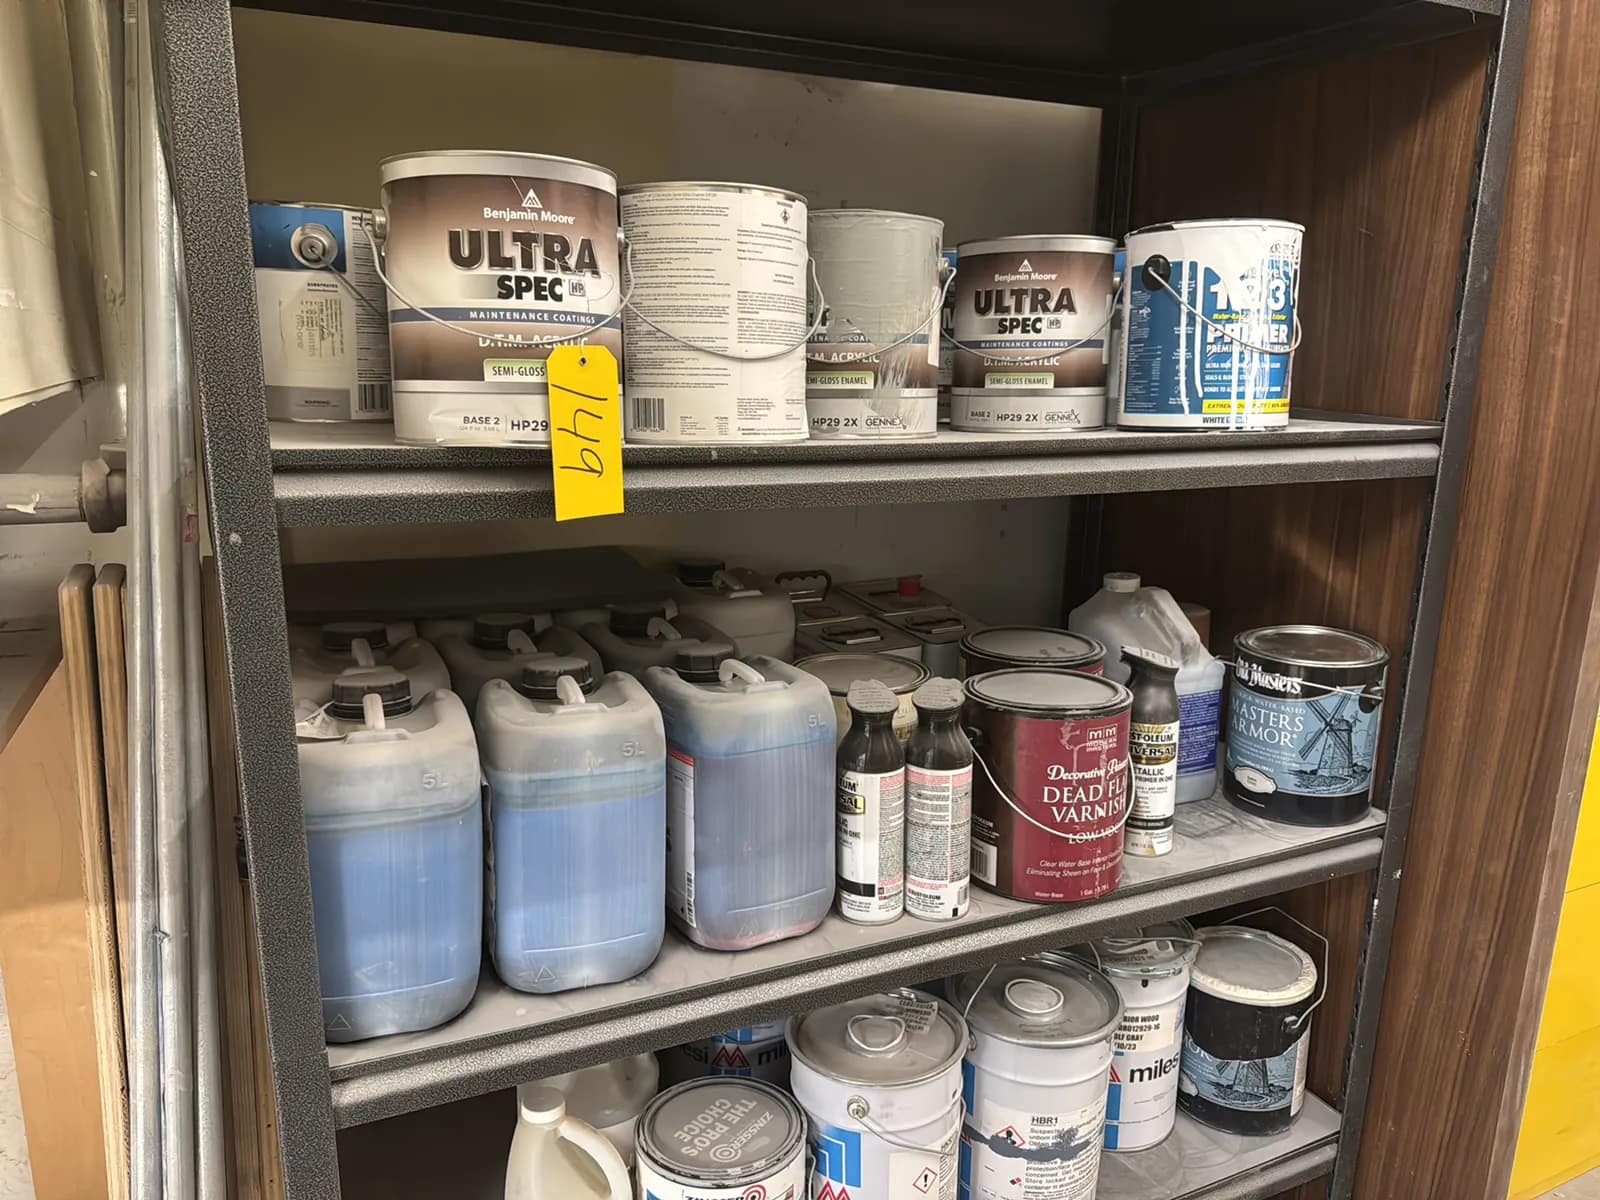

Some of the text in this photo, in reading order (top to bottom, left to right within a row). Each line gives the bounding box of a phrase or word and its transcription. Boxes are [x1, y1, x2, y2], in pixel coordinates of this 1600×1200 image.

[483, 207, 574, 224] Benjamin Moore
[448, 229, 601, 279] ULTRA
[994, 272, 1057, 282] Benjamin Moore
[497, 275, 563, 302] SPEC
[974, 288, 1077, 316] ULTRA
[469, 311, 595, 325] MAINTENANCE COATINGS
[998, 317, 1043, 335] SPEC
[492, 366, 546, 377] SEMI-GLOSS
[807, 376, 868, 385] EMI-GLOSS ENAMEL
[990, 377, 1049, 385] SEMI-GLOSS ENAMEL
[463, 416, 501, 425] BASE 2
[812, 418, 858, 427] HP29 2X
[997, 413, 1038, 422] HP29 2X
[1202, 416, 1224, 424] WHITE
[511, 420, 549, 432] HP29
[550, 384, 608, 478] 149
[1231, 696, 1305, 732] MASTERS
[808, 714, 827, 728] 5L
[1131, 732, 1173, 742] ST-OLEUM
[1231, 714, 1295, 748] ARMOR
[1130, 746, 1174, 756] IVERSAL
[1043, 784, 1103, 803] DEAD
[1058, 860, 1076, 868] Water
[1026, 867, 1061, 878] Eliminating
[674, 1099, 731, 1142] CHOICE
[1032, 1116, 1058, 1124] HBR1
[681, 1100, 757, 1157] THE PRO'S
[731, 1112, 773, 1150] ZINSSER
